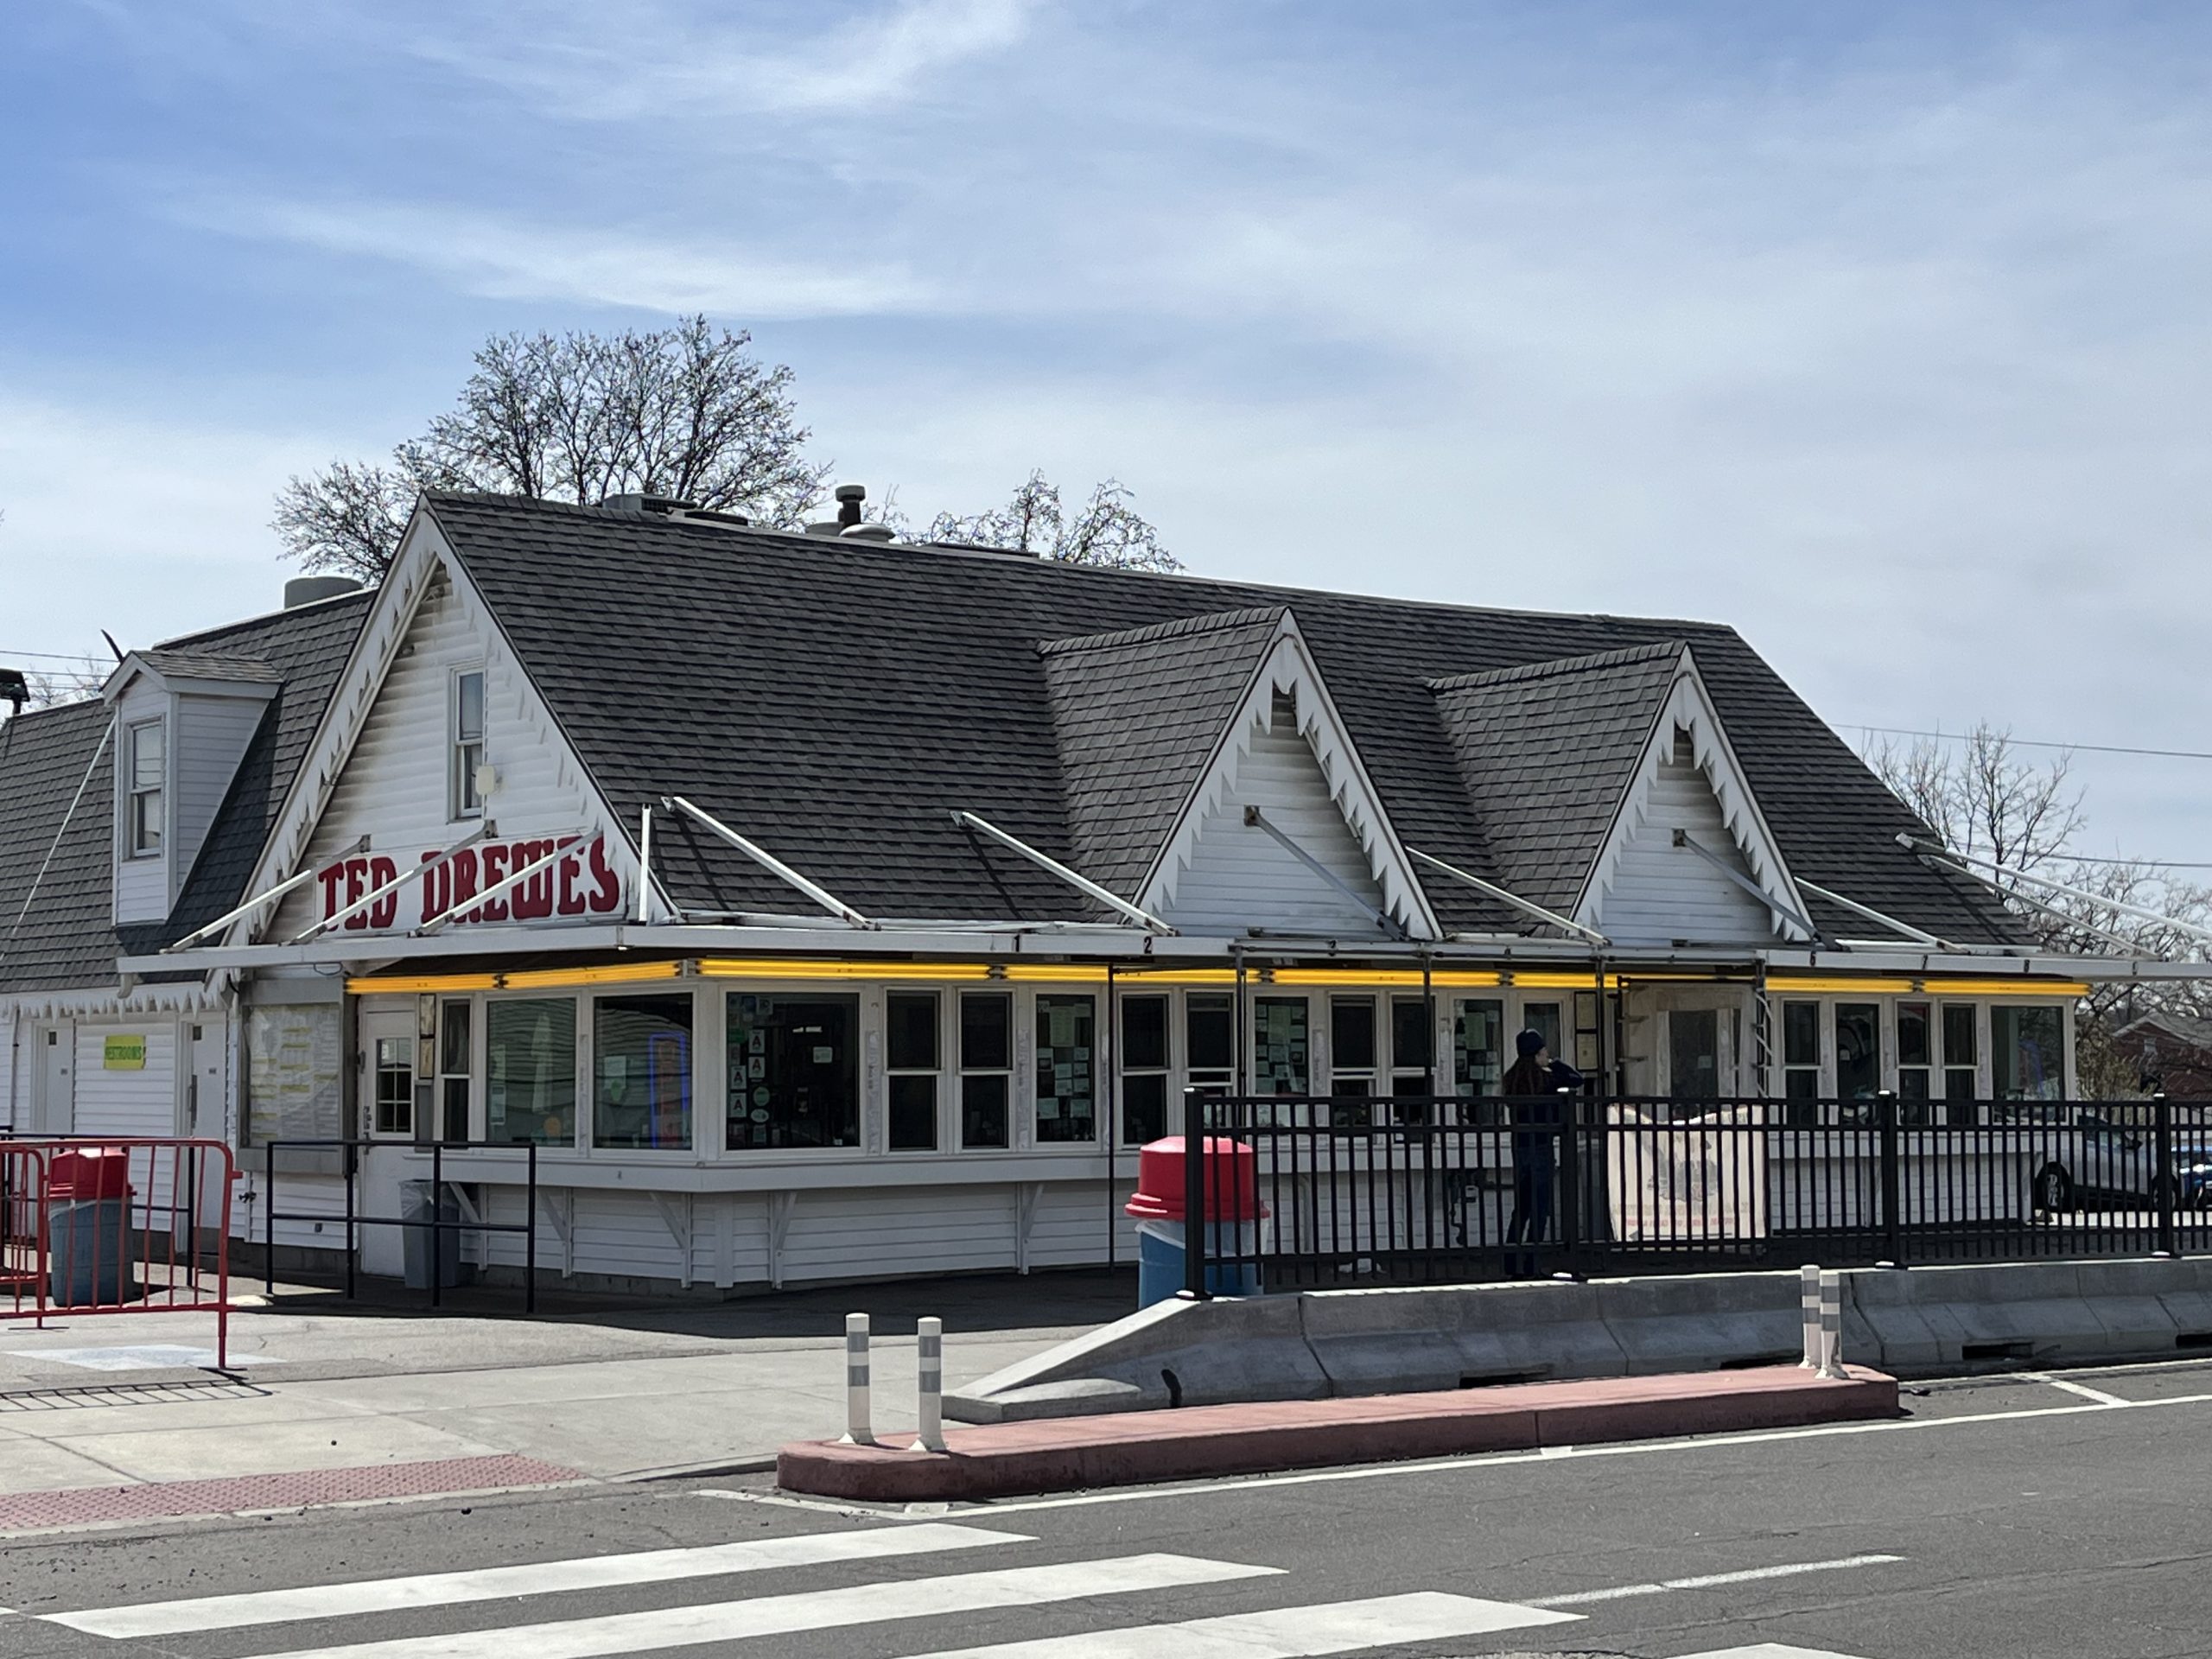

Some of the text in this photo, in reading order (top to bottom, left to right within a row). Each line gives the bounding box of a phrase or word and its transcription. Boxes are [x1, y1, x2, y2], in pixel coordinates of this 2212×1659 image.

[318, 835, 620, 931] TED DREWES
[1014, 934, 1020, 952] 1
[1143, 936, 1152, 954] 2
